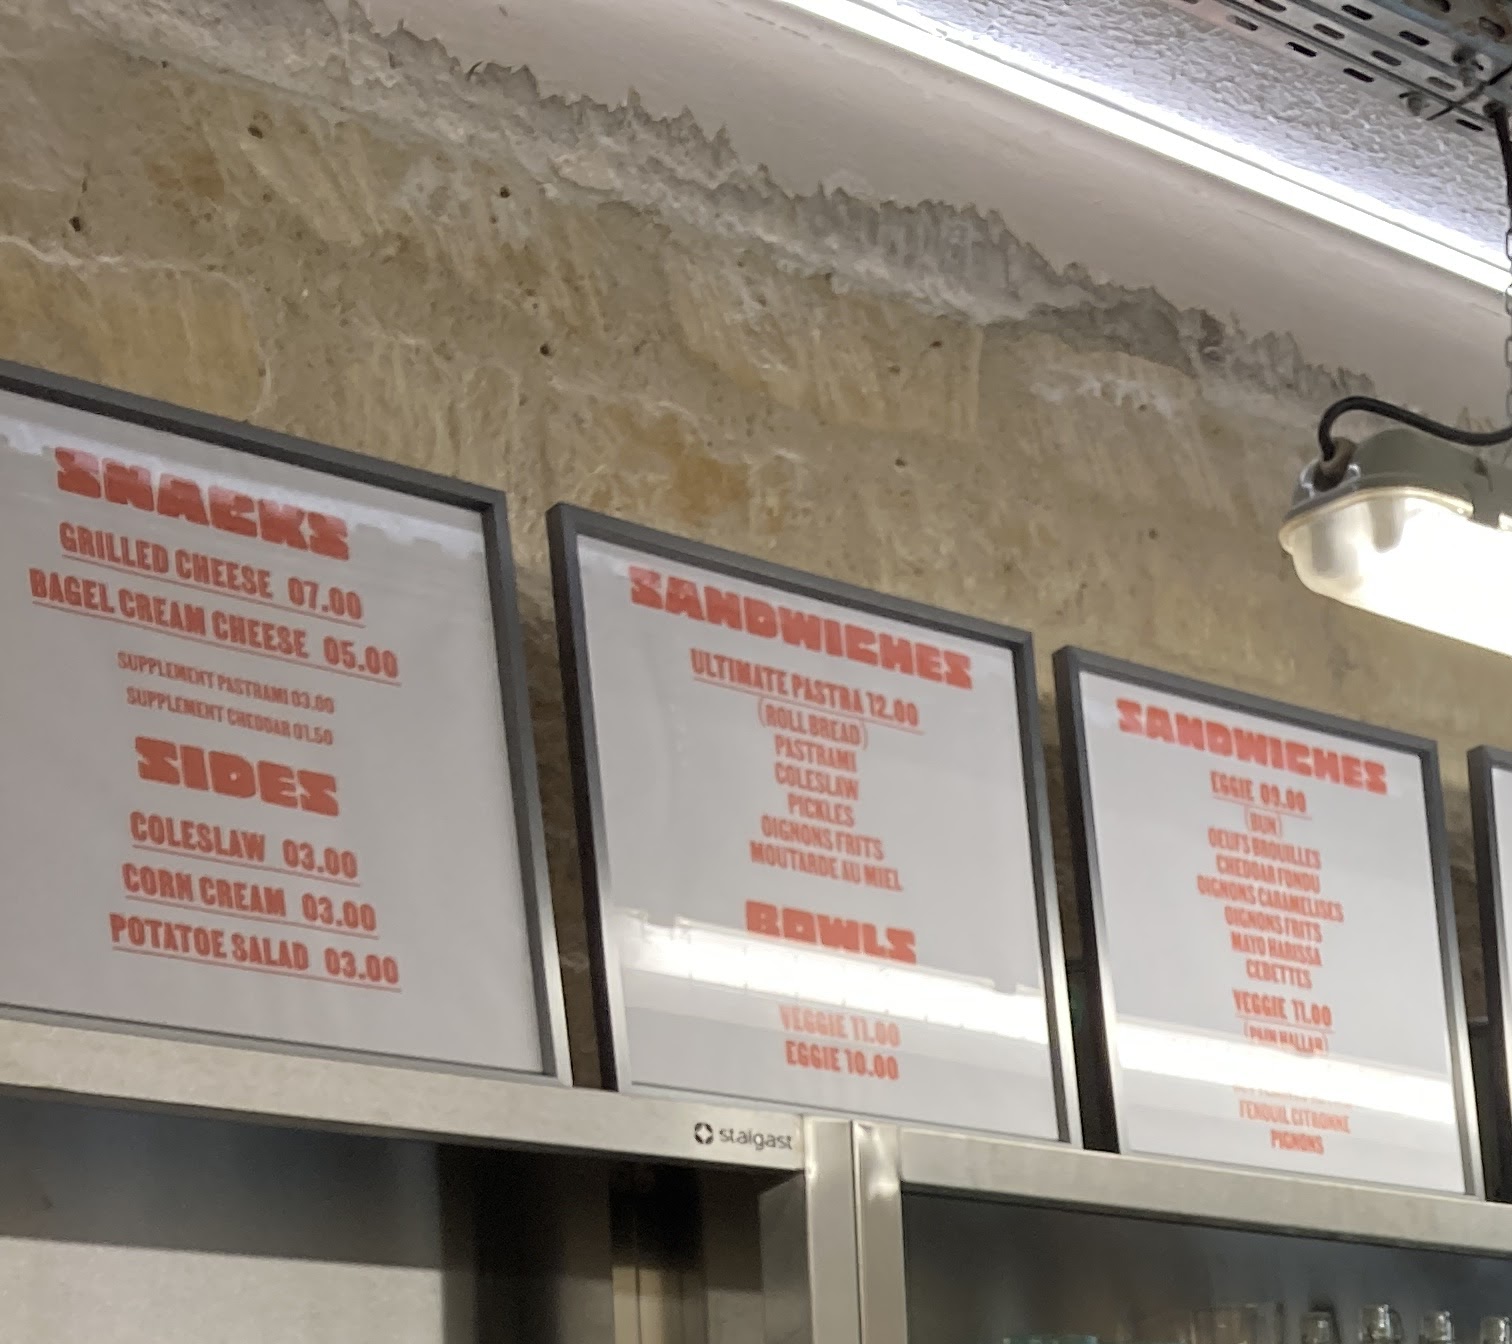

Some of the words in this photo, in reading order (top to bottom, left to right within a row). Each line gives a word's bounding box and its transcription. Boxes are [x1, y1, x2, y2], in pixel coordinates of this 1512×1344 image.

[54, 447, 350, 561] SNACKS
[59, 521, 169, 575] GRILLED
[175, 548, 273, 599] CHEESE
[288, 576, 364, 620] 07.00
[29, 568, 115, 614] BAGEL
[118, 588, 206, 636] CREAM
[211, 609, 310, 659] CHEESE
[323, 635, 399, 678] 05.00
[629, 564, 973, 690] SANDWICHES
[117, 651, 216, 689] SUPPLEMENT
[217, 673, 288, 705] PASTRAMI
[690, 648, 789, 694] ULTIMATE
[791, 672, 864, 714] PASTRA
[866, 690, 920, 727] 12.00
[126, 686, 225, 723] SUPPLEMENT
[227, 708, 291, 738] CHEDDAR
[774, 734, 858, 773] PASTRAMI
[1116, 697, 1387, 795] SANDWICHES
[135, 736, 340, 817] SIDES
[774, 762, 859, 800] COLESLAW
[1210, 770, 1254, 802] EGGIE
[787, 792, 855, 828] PICKLES
[130, 810, 266, 862] COLESLAW
[282, 838, 358, 879] 03.00
[761, 815, 833, 850] OIGNONS
[835, 831, 884, 861] FRITS
[749, 840, 838, 880] MOUTARDE
[841, 860, 861, 885] AU
[863, 864, 903, 891] MIEL
[1197, 875, 1256, 904] OIGNONS
[1216, 854, 1277, 883] CHEDDAR
[121, 862, 193, 901] CORN
[199, 875, 286, 917] CREAM
[301, 892, 377, 932] 03.00
[1224, 906, 1283, 934] OIGNONS
[110, 912, 228, 959] POTATOE
[231, 932, 310, 971] SALAD
[324, 947, 399, 985] 03.00
[745, 899, 917, 965] BOWLS
[1231, 931, 1266, 956] MAYO
[1268, 936, 1322, 967] HARISSA
[778, 1003, 848, 1039] VEGGIE
[851, 1014, 901, 1048] 11.00
[1232, 988, 1287, 1019] VEGGIE
[1291, 998, 1332, 1027] 11.00
[785, 1039, 841, 1072] EGGIE
[845, 1048, 899, 1081] 10.00
[719, 1128, 793, 1151] stalgast
